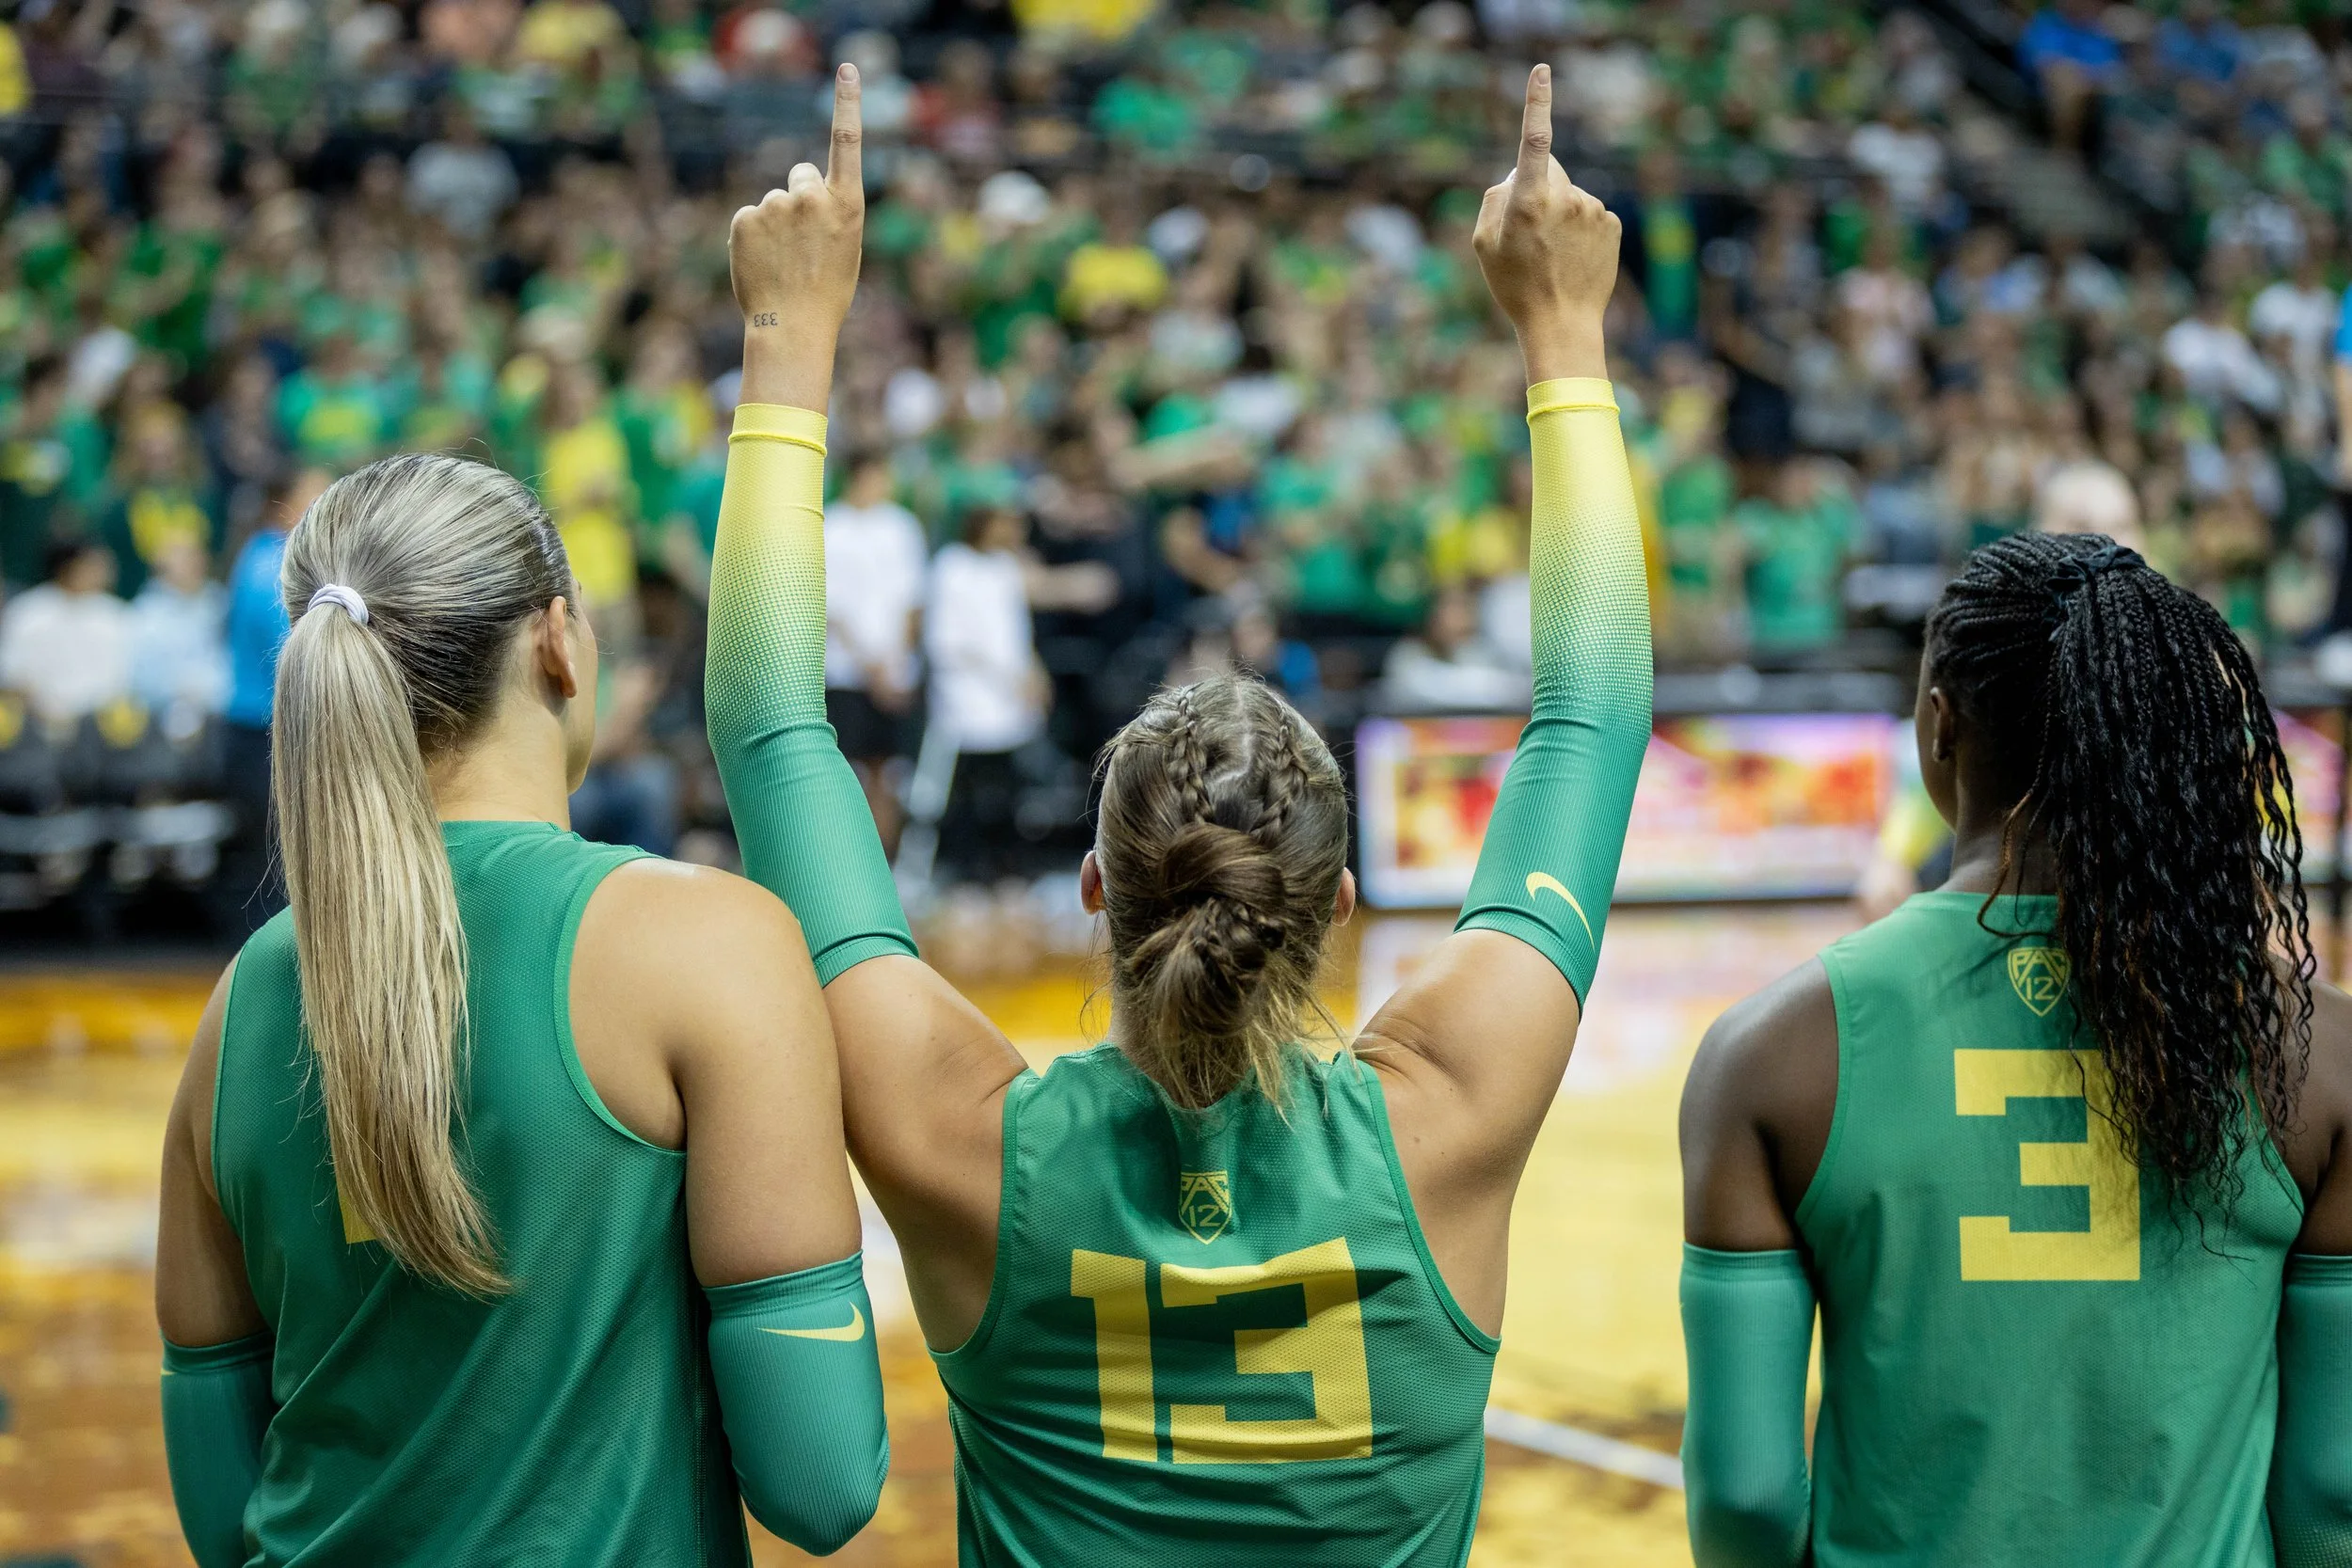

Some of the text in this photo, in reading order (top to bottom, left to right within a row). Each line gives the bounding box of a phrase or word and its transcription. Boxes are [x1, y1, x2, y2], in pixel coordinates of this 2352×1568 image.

[2026, 977, 2056, 1000] 12
[1189, 1204, 1221, 1227] 12
[1954, 1049, 2140, 1281] 3
[1071, 1237, 1373, 1465] 13
